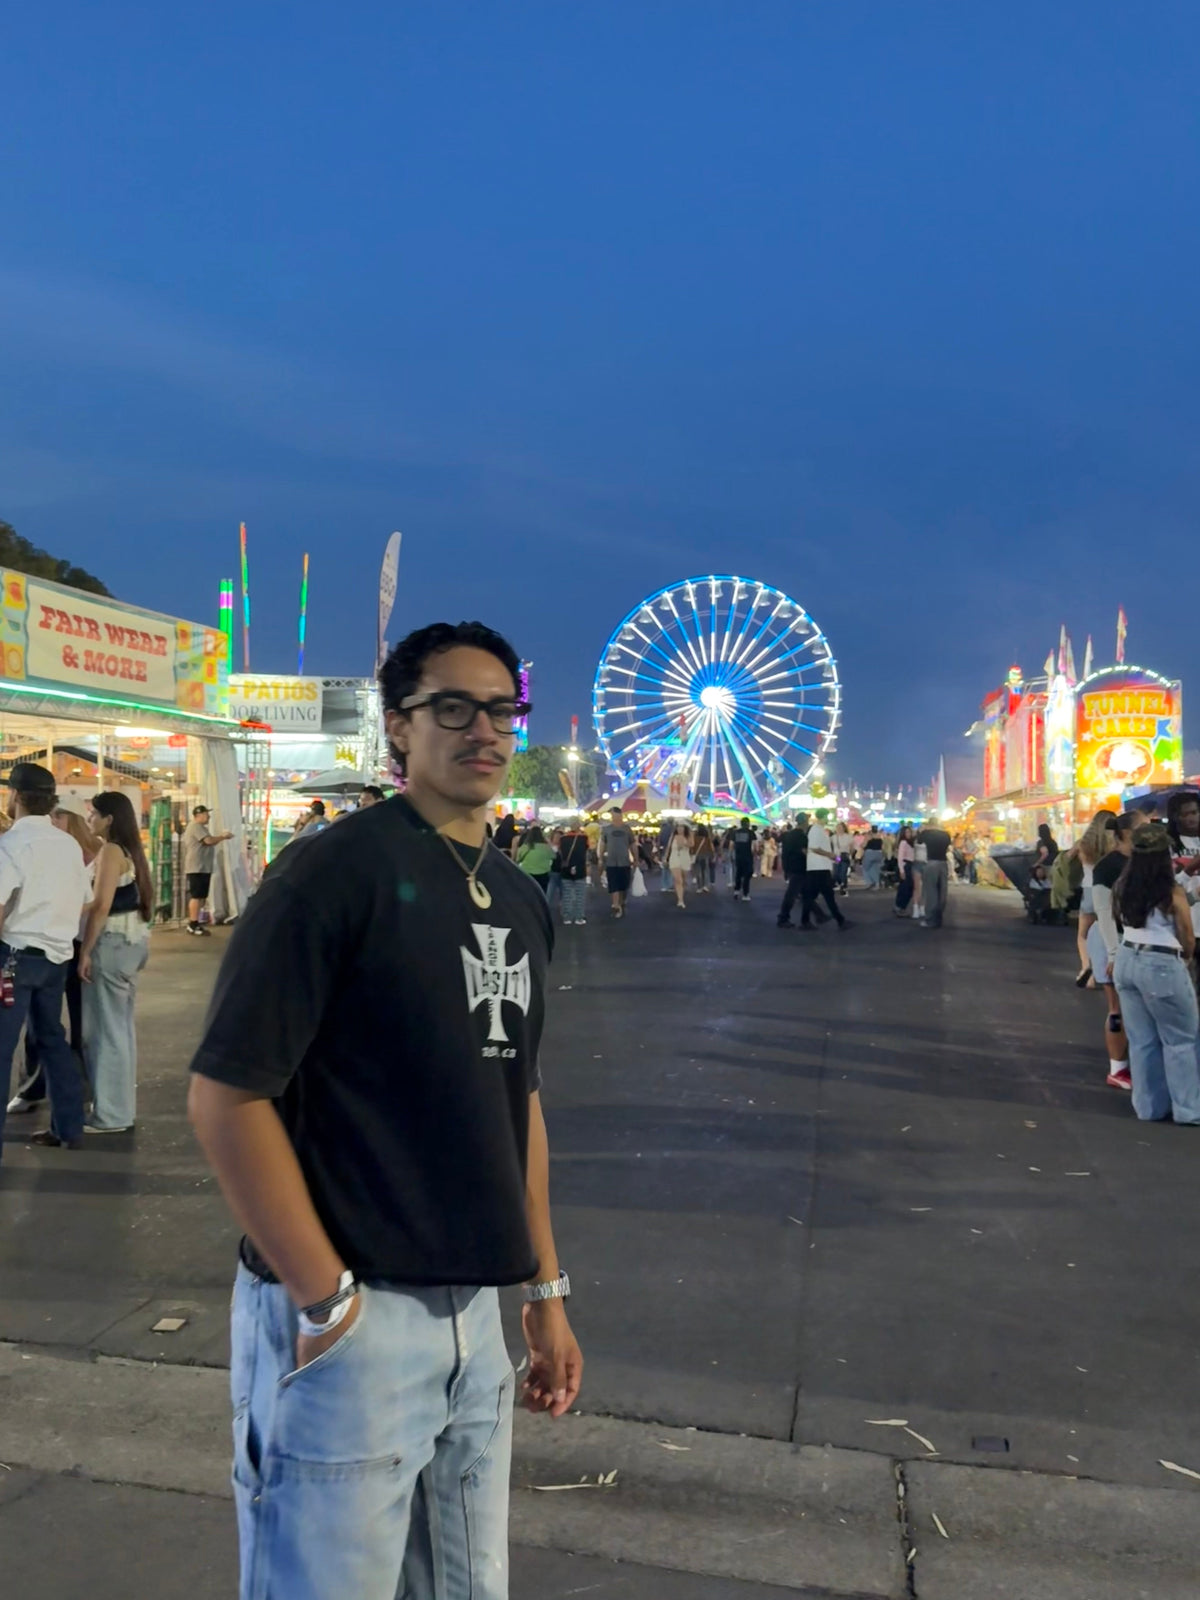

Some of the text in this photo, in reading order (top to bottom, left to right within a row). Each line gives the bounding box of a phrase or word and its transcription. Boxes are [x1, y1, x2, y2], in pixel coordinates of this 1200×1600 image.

[38, 604, 168, 657] FAIR WEAR
[62, 644, 148, 683] & MORE
[243, 680, 318, 701] PATIOS
[1083, 690, 1170, 718] FUNNEL
[264, 705, 317, 722] LIVING
